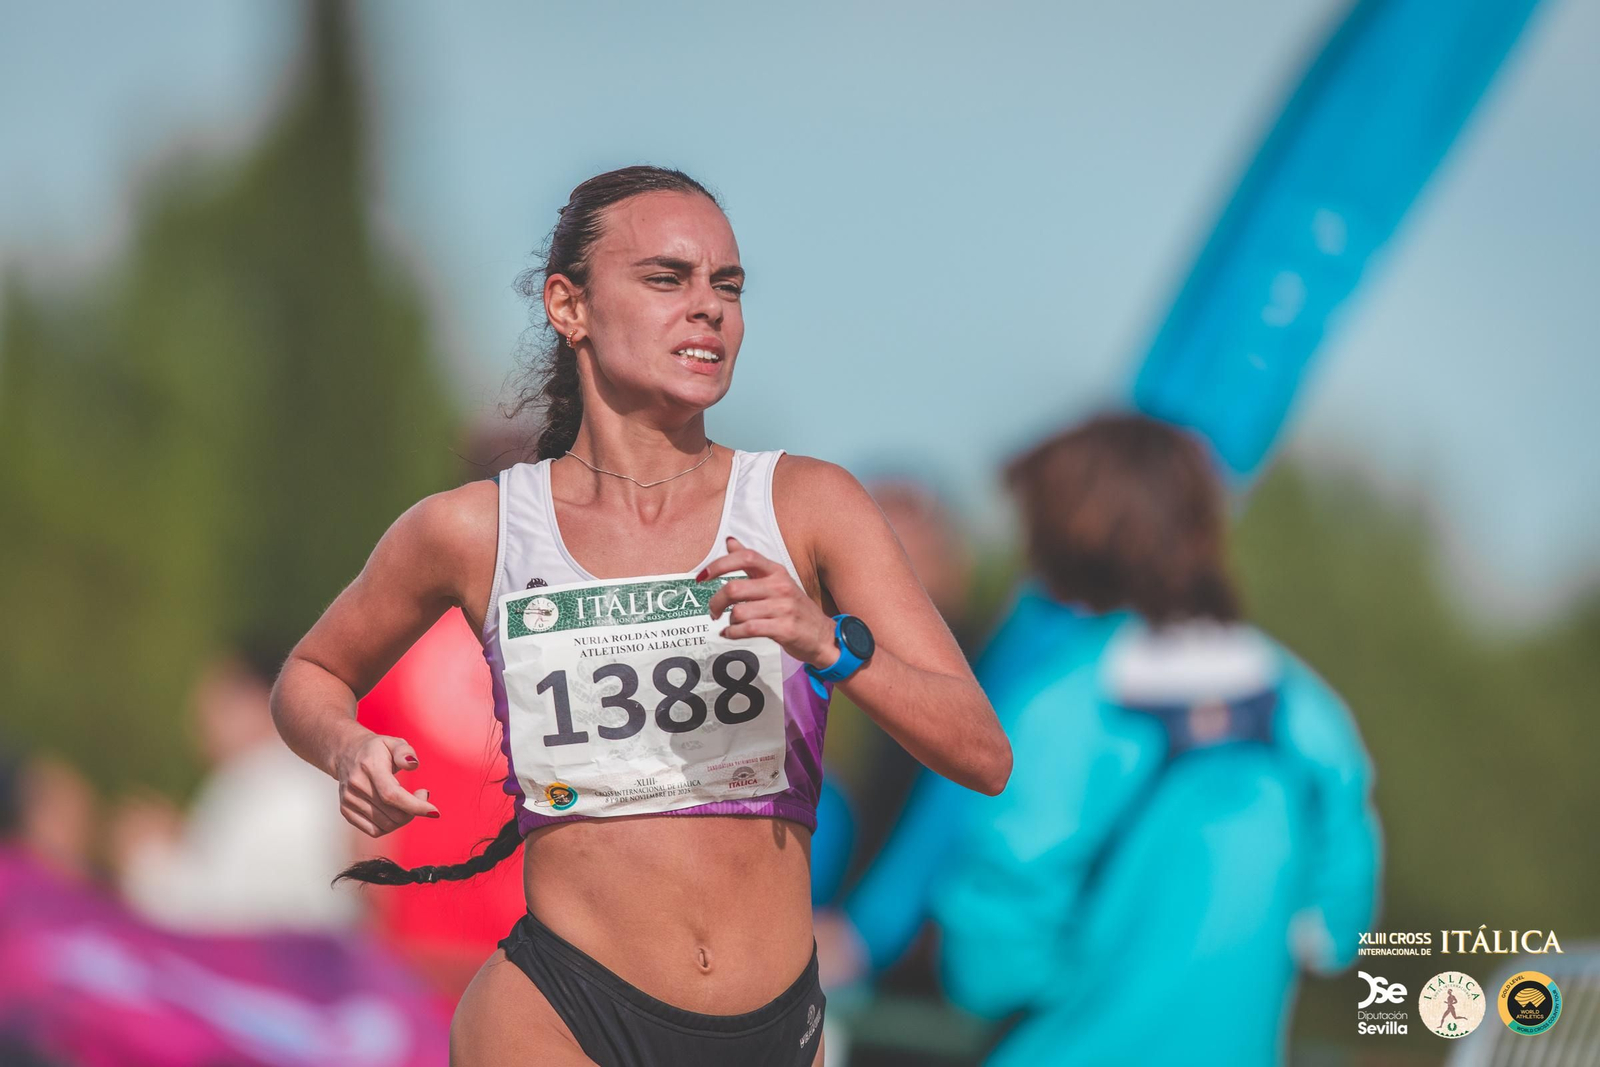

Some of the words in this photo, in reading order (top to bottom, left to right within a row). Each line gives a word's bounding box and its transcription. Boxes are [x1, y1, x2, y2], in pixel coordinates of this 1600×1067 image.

[576, 588, 702, 619] ITÁLICA
[667, 608, 703, 618] COUNTRY
[574, 636, 609, 647] NURIA
[611, 630, 658, 643] ROLDÁN
[660, 624, 709, 638] MOROTE
[579, 643, 645, 658] ATLETISMO
[647, 636, 707, 652] ALBACETE
[536, 649, 765, 747] 1388
[614, 784, 666, 797] INTERNACIONAL
[629, 792, 666, 802] NOVIEMBRE
